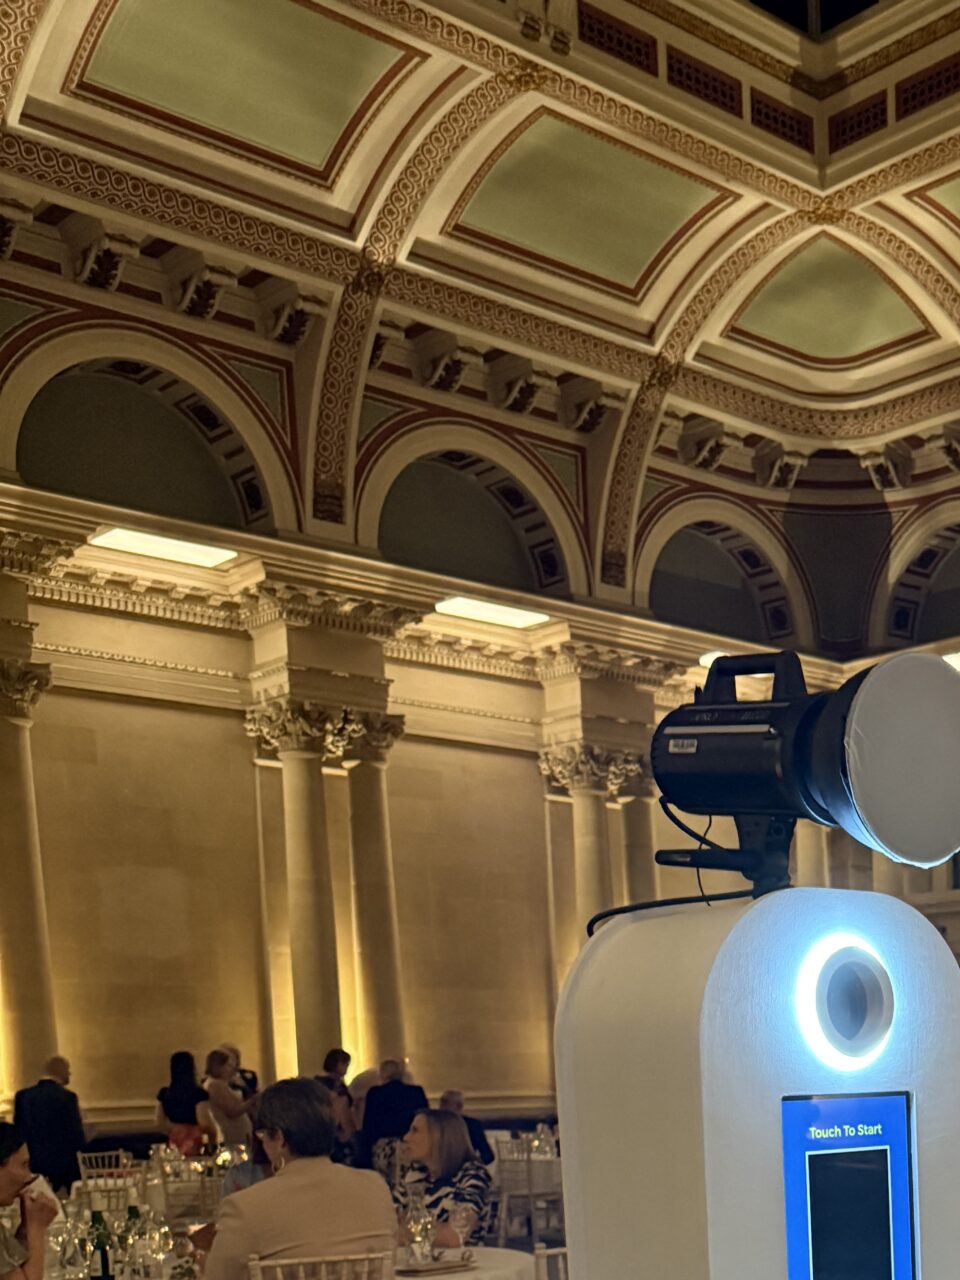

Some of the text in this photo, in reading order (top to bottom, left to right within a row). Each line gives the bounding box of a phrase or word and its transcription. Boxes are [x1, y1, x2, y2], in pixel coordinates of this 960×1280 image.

[808, 1124, 882, 1140] Touch To Start
